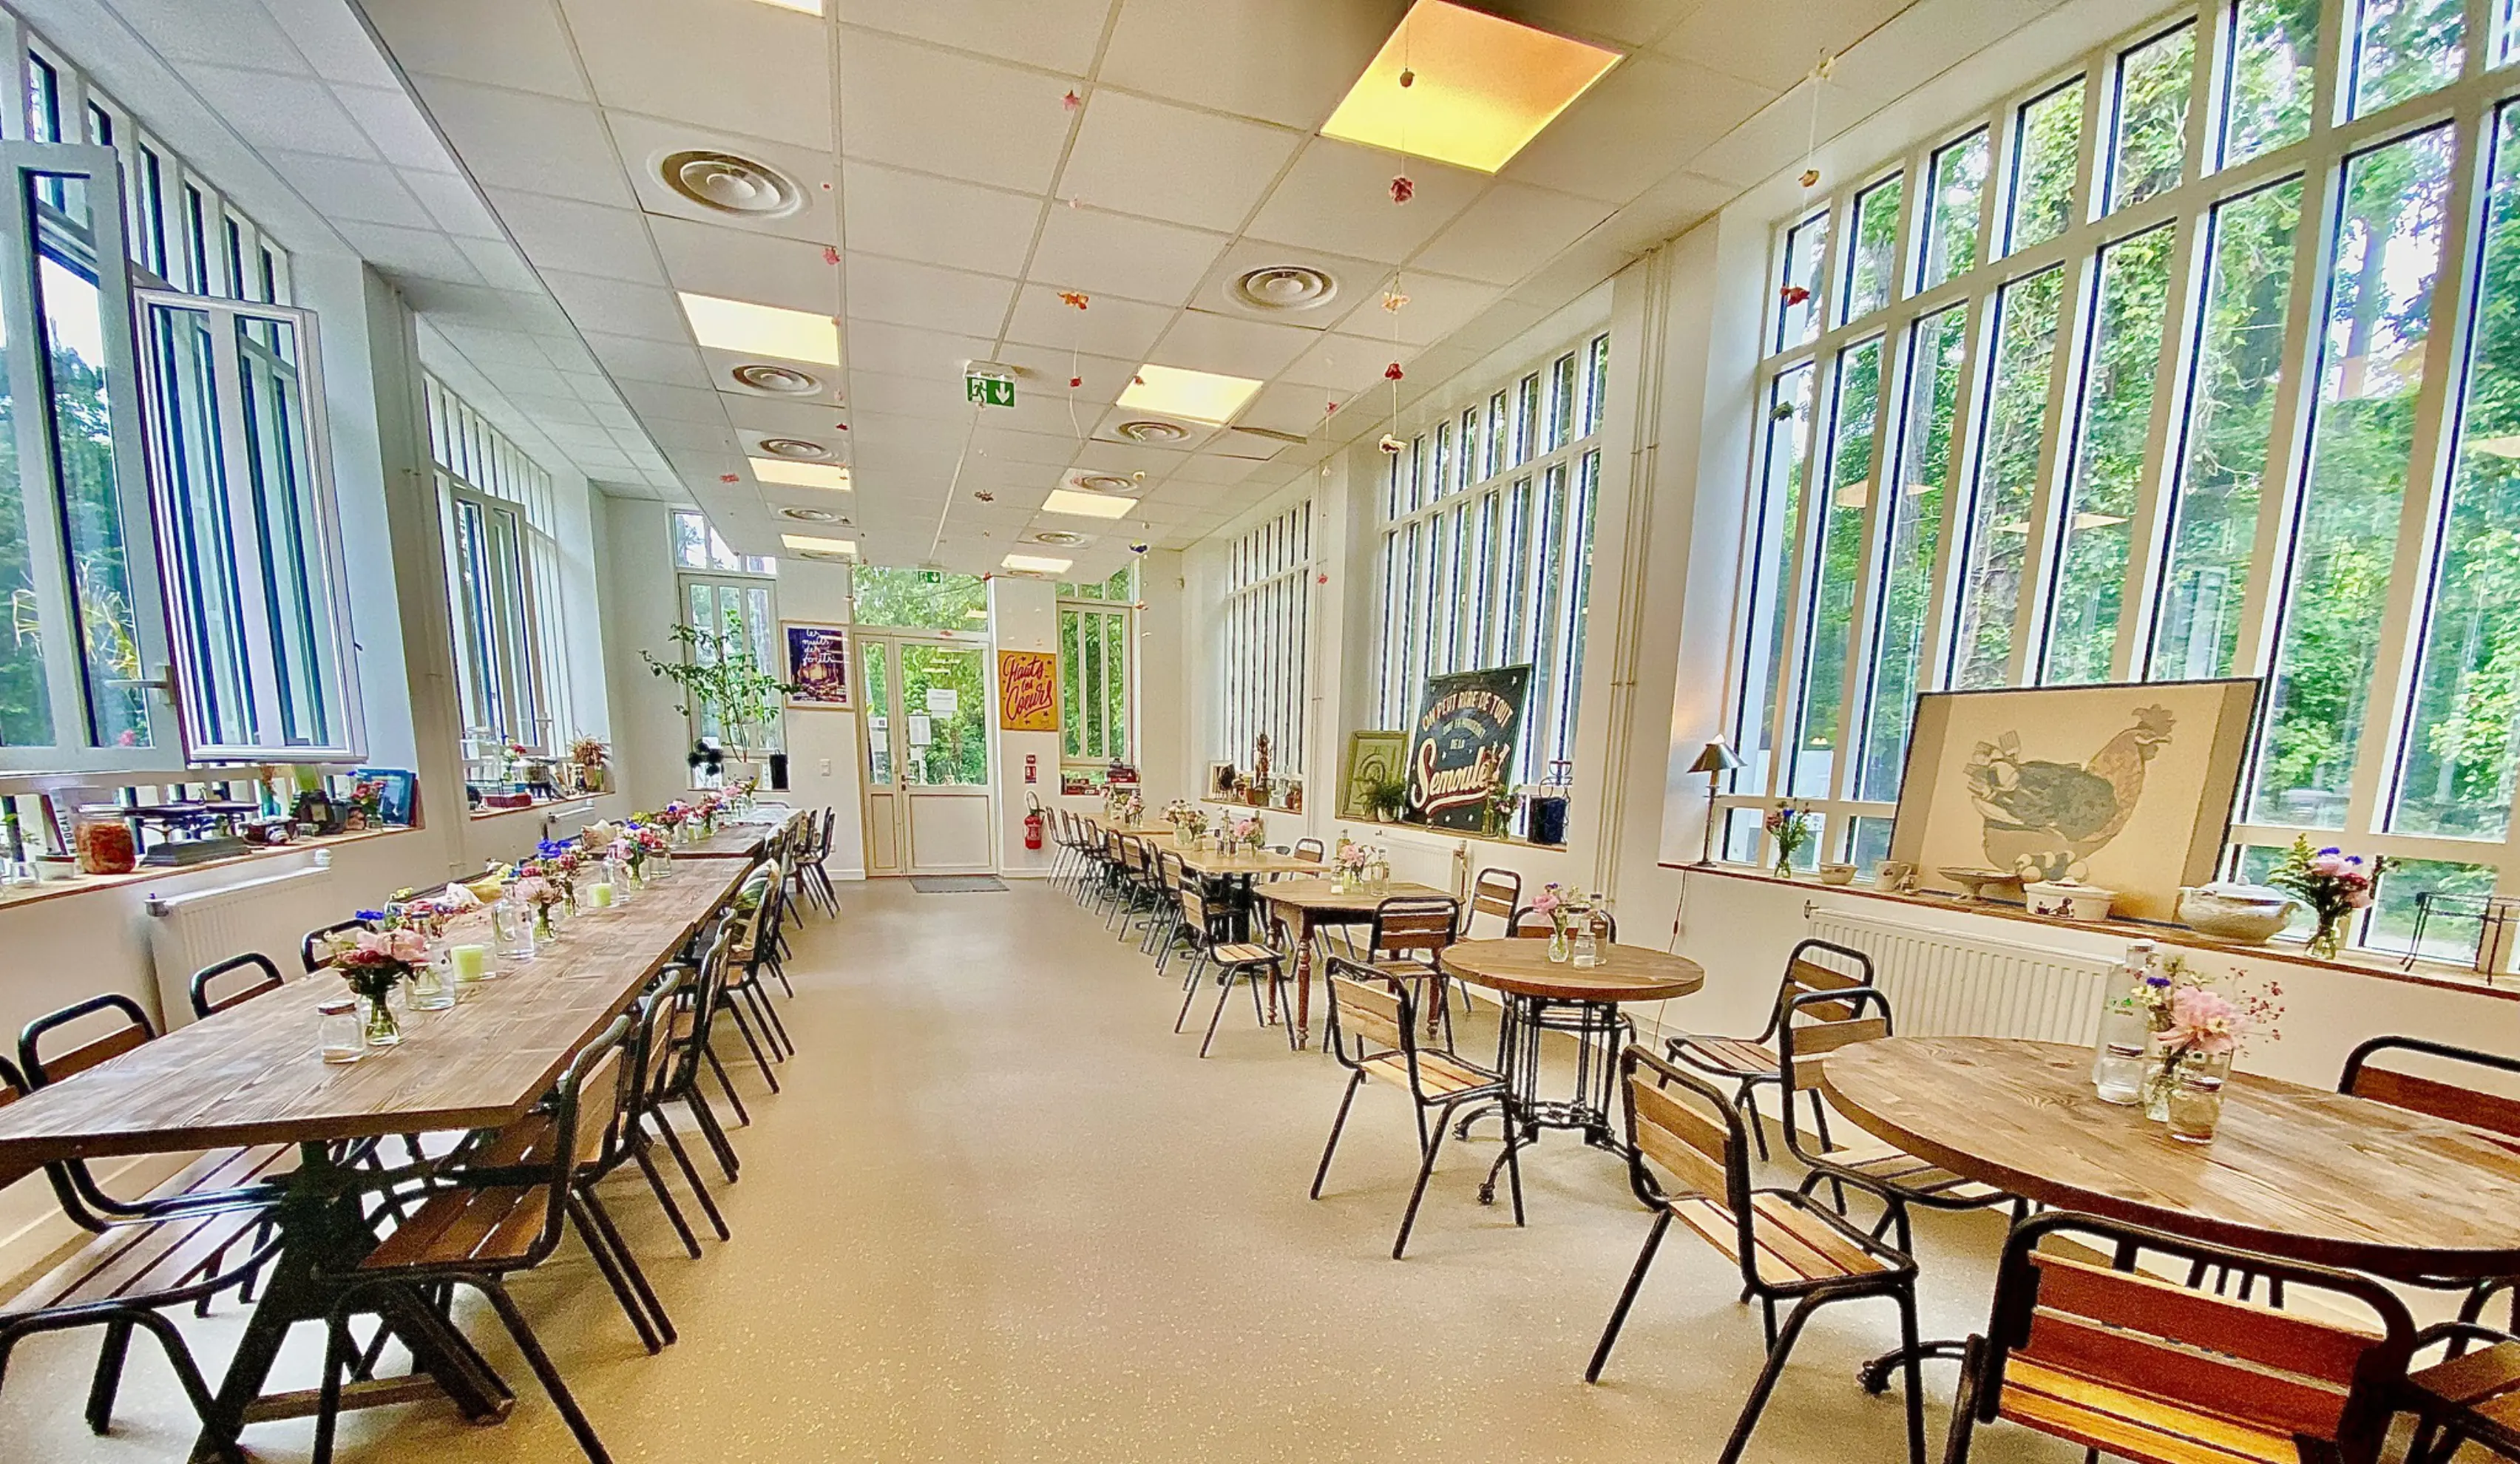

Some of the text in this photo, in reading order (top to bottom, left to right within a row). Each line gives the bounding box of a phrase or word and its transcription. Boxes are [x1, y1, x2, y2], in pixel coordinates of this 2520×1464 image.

[1003, 654, 1043, 693] Hauts
[1421, 707, 1436, 732] ON
[1436, 694, 1457, 719] PEUT
[1458, 691, 1478, 708] RIRE
[1477, 691, 1492, 711] DE
[1489, 694, 1514, 728] TOUT
[58, 816, 75, 844] BOCAL
